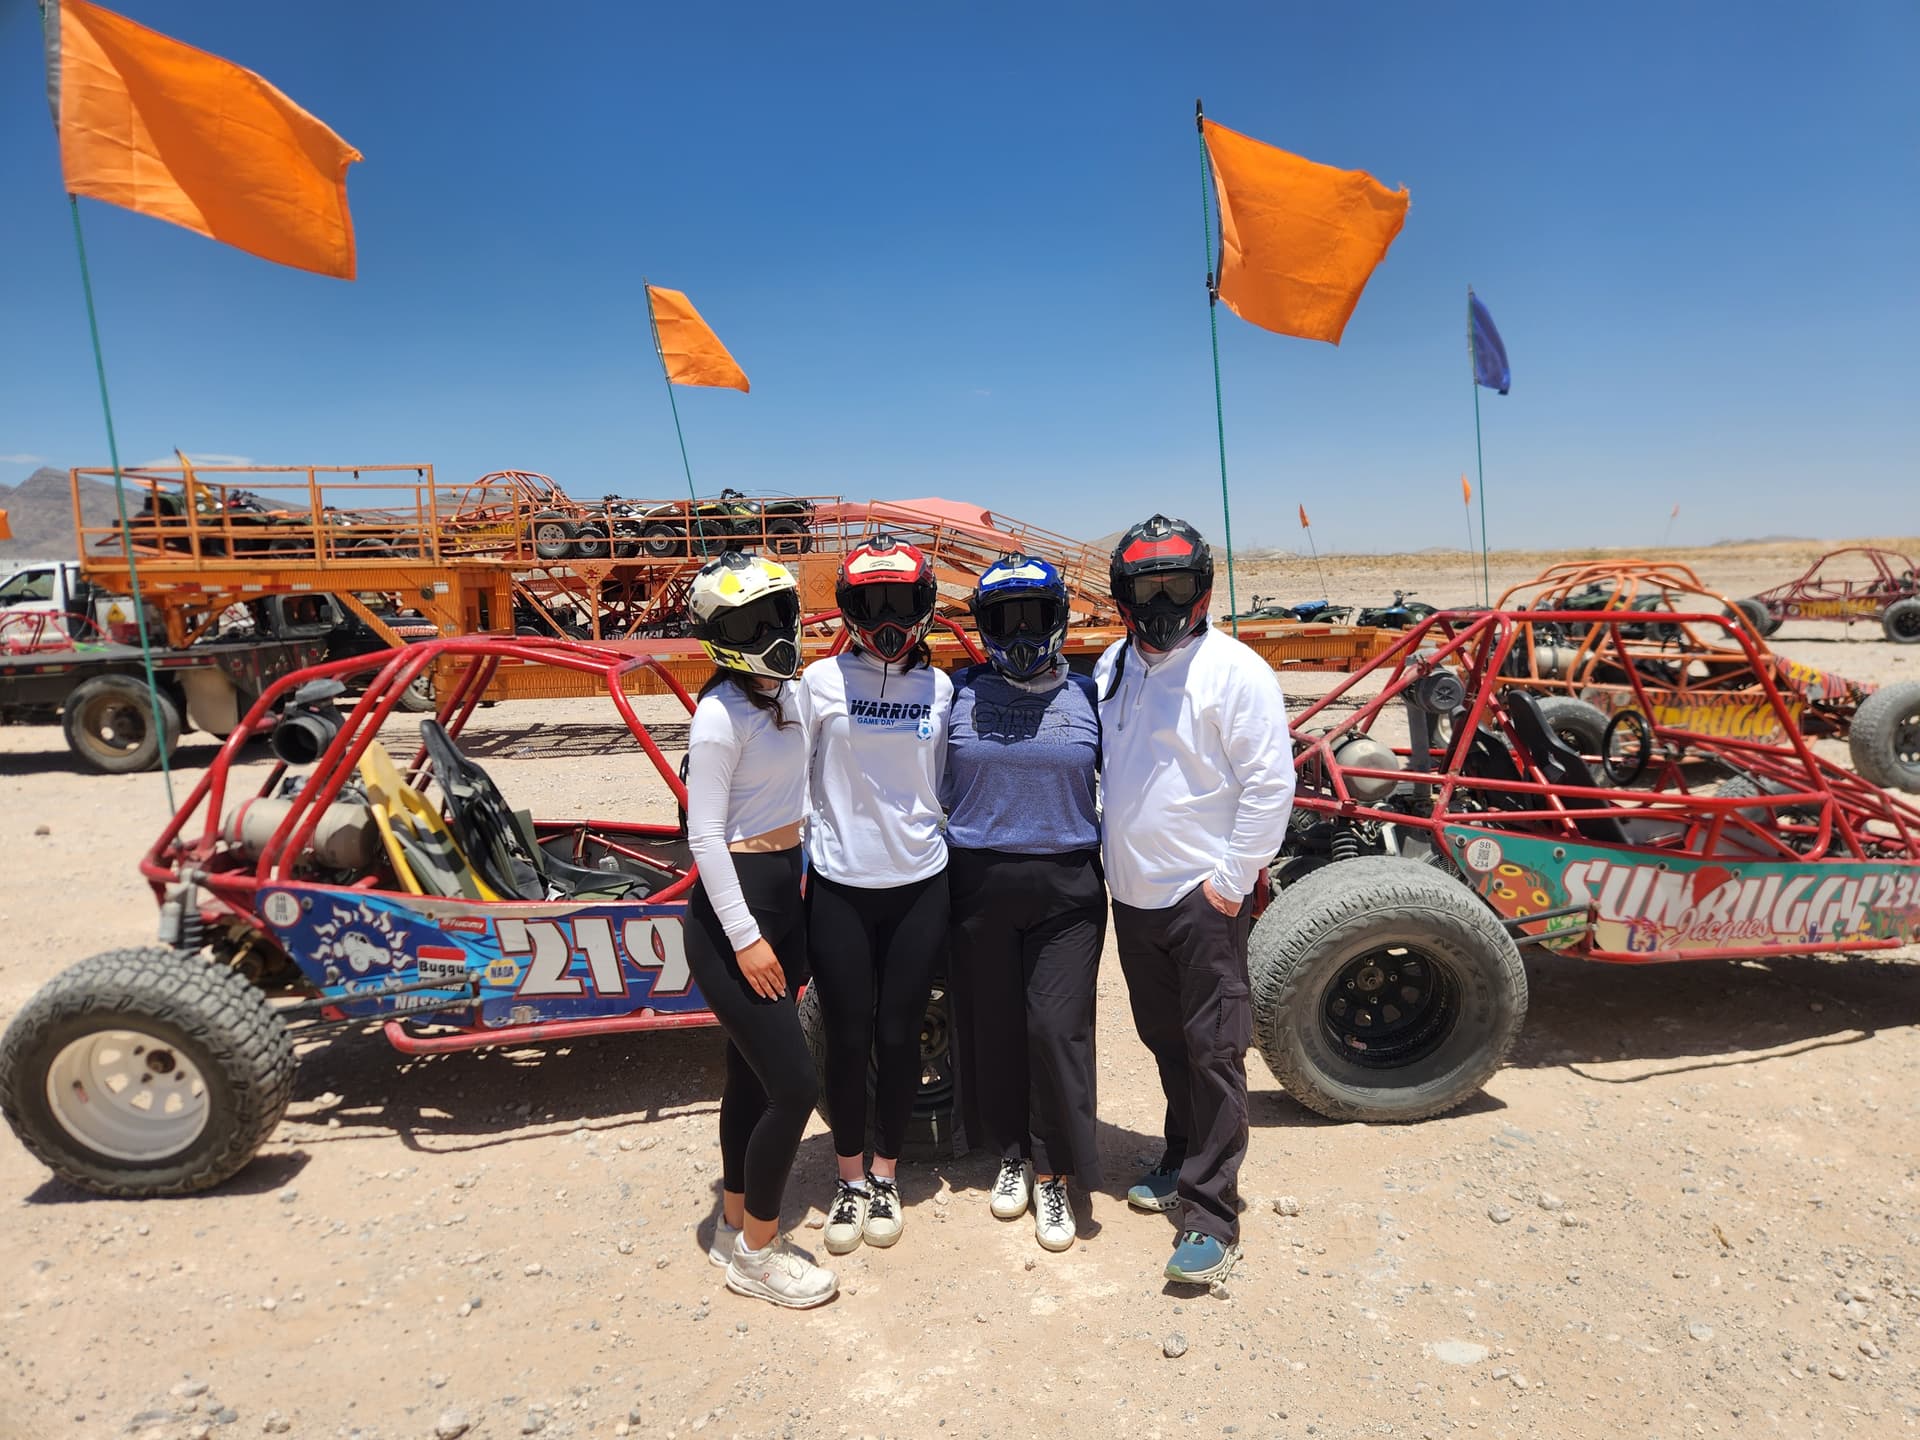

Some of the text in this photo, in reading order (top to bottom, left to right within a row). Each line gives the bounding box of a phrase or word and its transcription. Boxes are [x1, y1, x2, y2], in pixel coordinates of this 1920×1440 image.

[850, 699, 932, 719] WARRIOR
[857, 716, 896, 726] GAME DAY
[1564, 860, 1880, 935] SUNBUGGY
[1657, 906, 1769, 950] Jacques
[495, 917, 692, 995] 219
